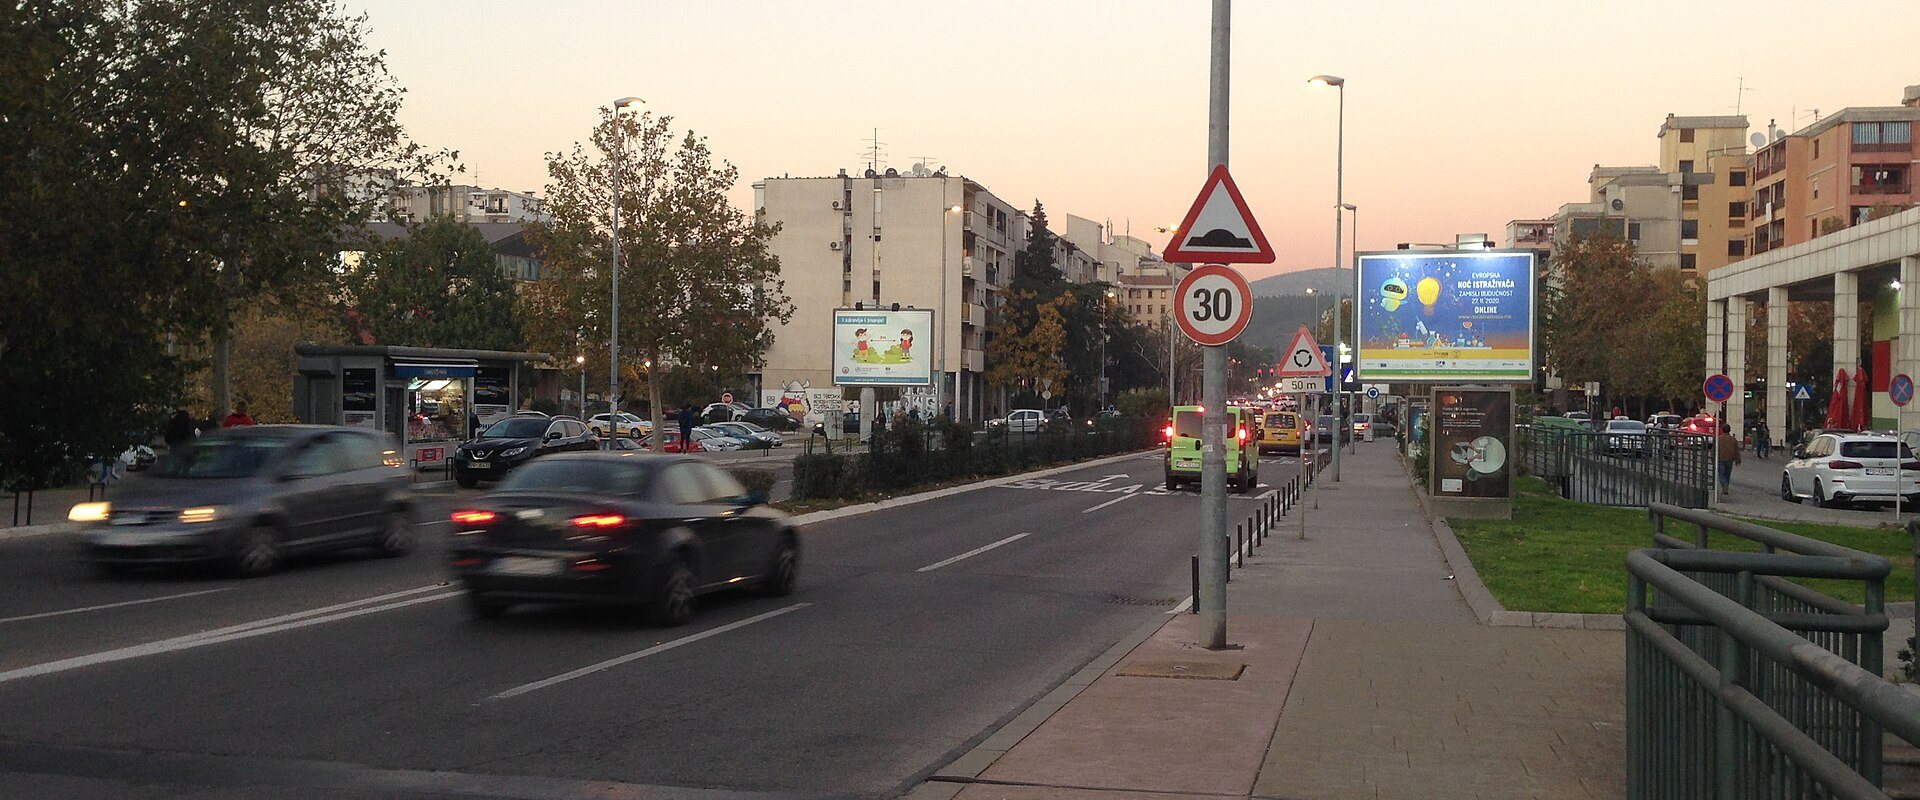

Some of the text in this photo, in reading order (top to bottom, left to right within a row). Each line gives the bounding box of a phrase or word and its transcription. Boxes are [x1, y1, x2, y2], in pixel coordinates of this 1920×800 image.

[1457, 278, 1515, 288] NOĆ ISTRAŽIVAČA
[1192, 288, 1232, 321] 30
[1291, 380, 1317, 390] 50 m
